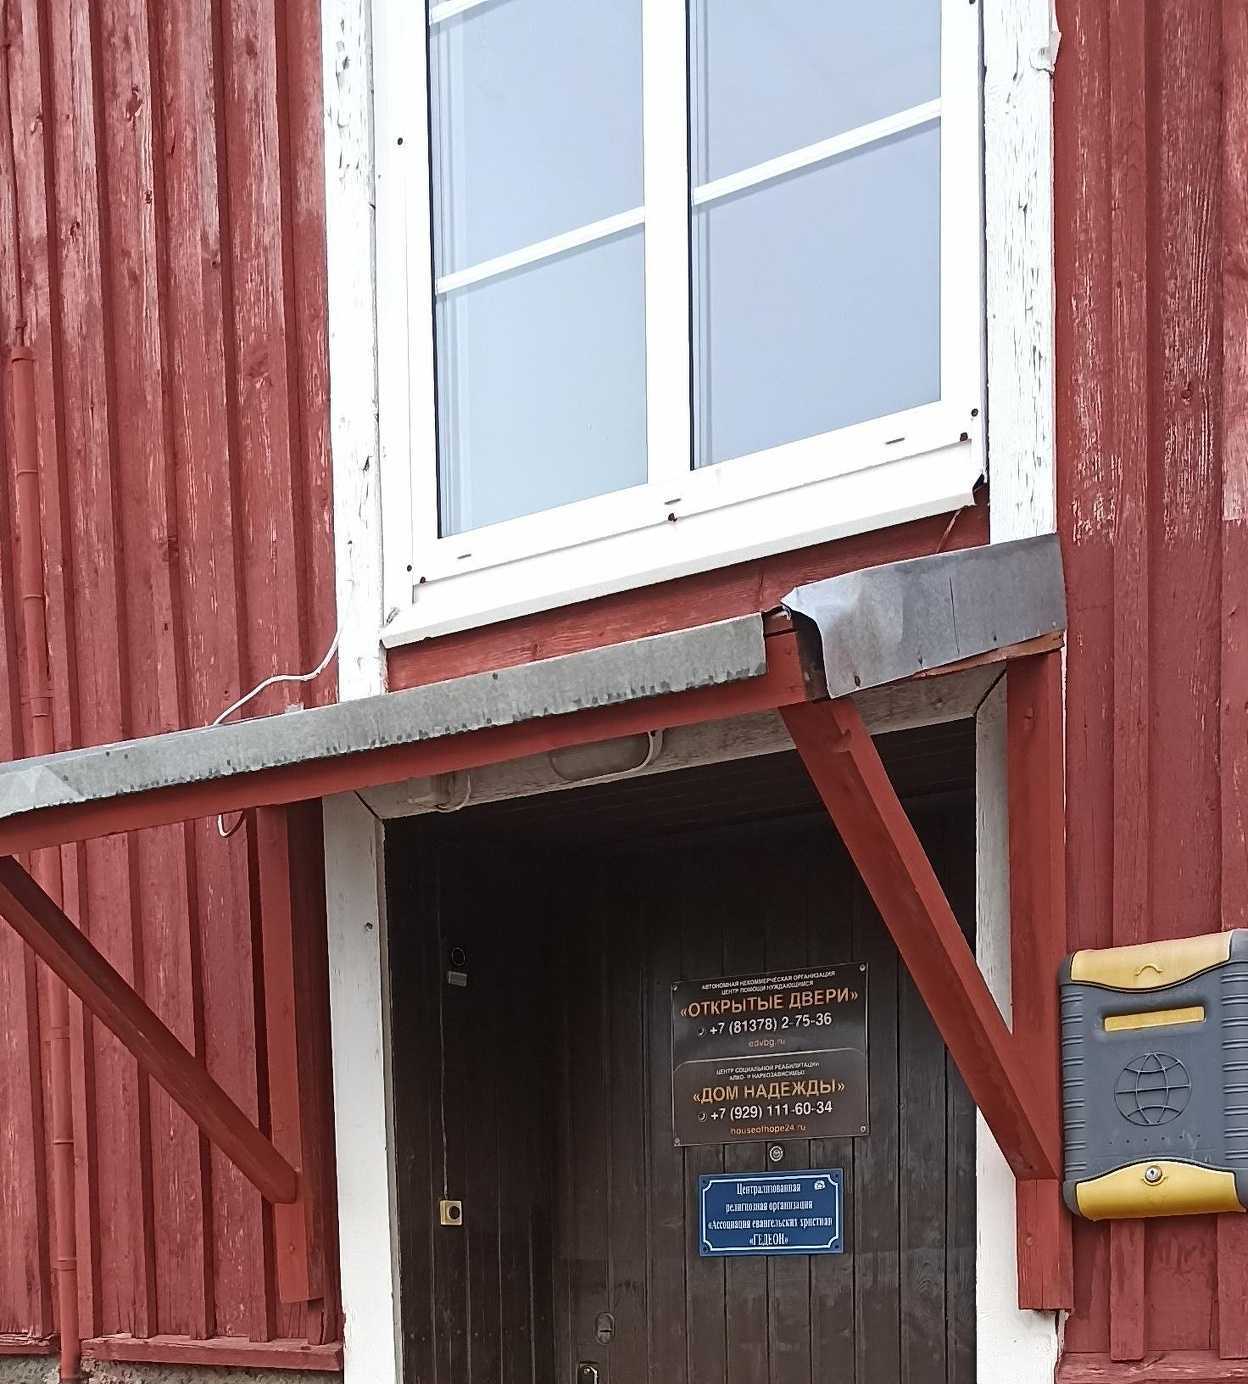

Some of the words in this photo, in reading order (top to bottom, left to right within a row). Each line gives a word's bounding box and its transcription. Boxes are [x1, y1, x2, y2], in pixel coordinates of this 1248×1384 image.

[793, 970, 836, 980] ОРГАНИЗАЦИЯ
[721, 988, 739, 996] ЦЕНТР
[740, 985, 766, 994] ПОМОЩИ
[766, 980, 814, 991] НУЖДАЮЩИМСЯ
[680, 994, 784, 1018] «ОТКРЫТЫЕ
[789, 987, 859, 1009] ДВЕРИ»
[709, 1022, 725, 1035] +7
[728, 1018, 777, 1035] (81378)
[781, 1012, 832, 1029] 2-75-36
[716, 1067, 734, 1076] ЦЕНТР
[734, 1064, 774, 1074] СОЦИАЛЬНОЙ
[774, 1061, 820, 1070] РЕАБИЛИТАЦИИ
[692, 1085, 739, 1104] «ДОМ
[744, 1078, 845, 1100] НАДЕЖДЫ»
[710, 1107, 726, 1120] +7
[730, 1104, 763, 1121] (929)
[767, 1100, 833, 1117] 111-60-34
[736, 1183, 801, 1196] Централизованная
[725, 1203, 768, 1214] религиозная
[769, 1200, 813, 1212] организация
[708, 1220, 751, 1230] «Ассоциация
[752, 1218, 797, 1228] евангельских
[749, 1233, 789, 1246] «ГЕДЕОН»
